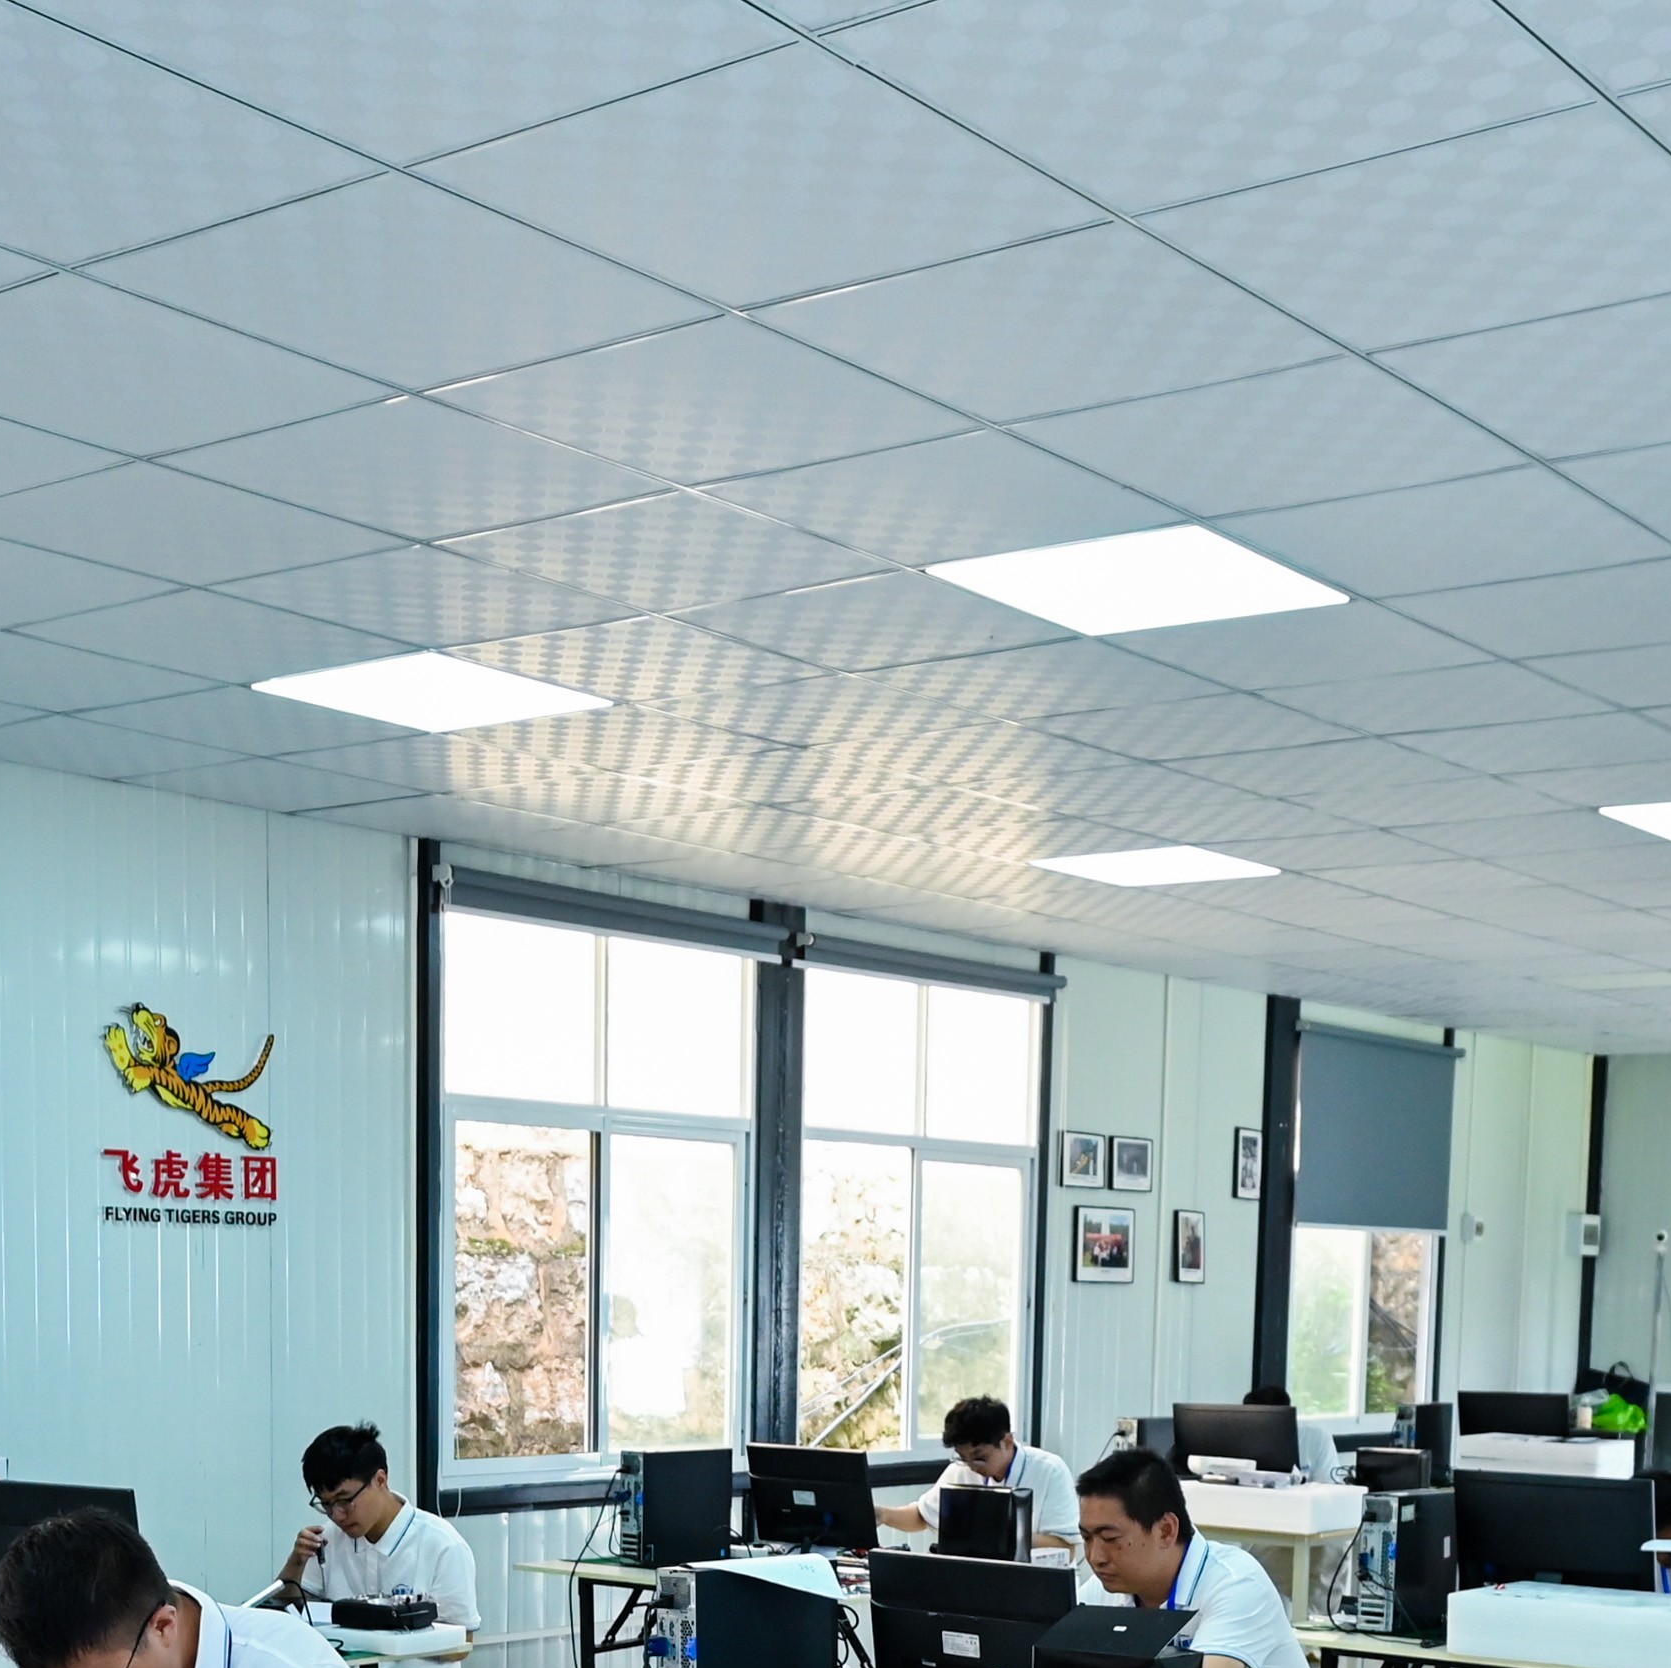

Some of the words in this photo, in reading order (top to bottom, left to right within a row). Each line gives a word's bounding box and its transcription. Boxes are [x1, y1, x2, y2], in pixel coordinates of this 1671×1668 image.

[103, 1149, 278, 1201] 飞虎集团
[104, 1207, 162, 1224] FLYING
[165, 1208, 221, 1225] TIGERS
[225, 1210, 277, 1226] GROUP
